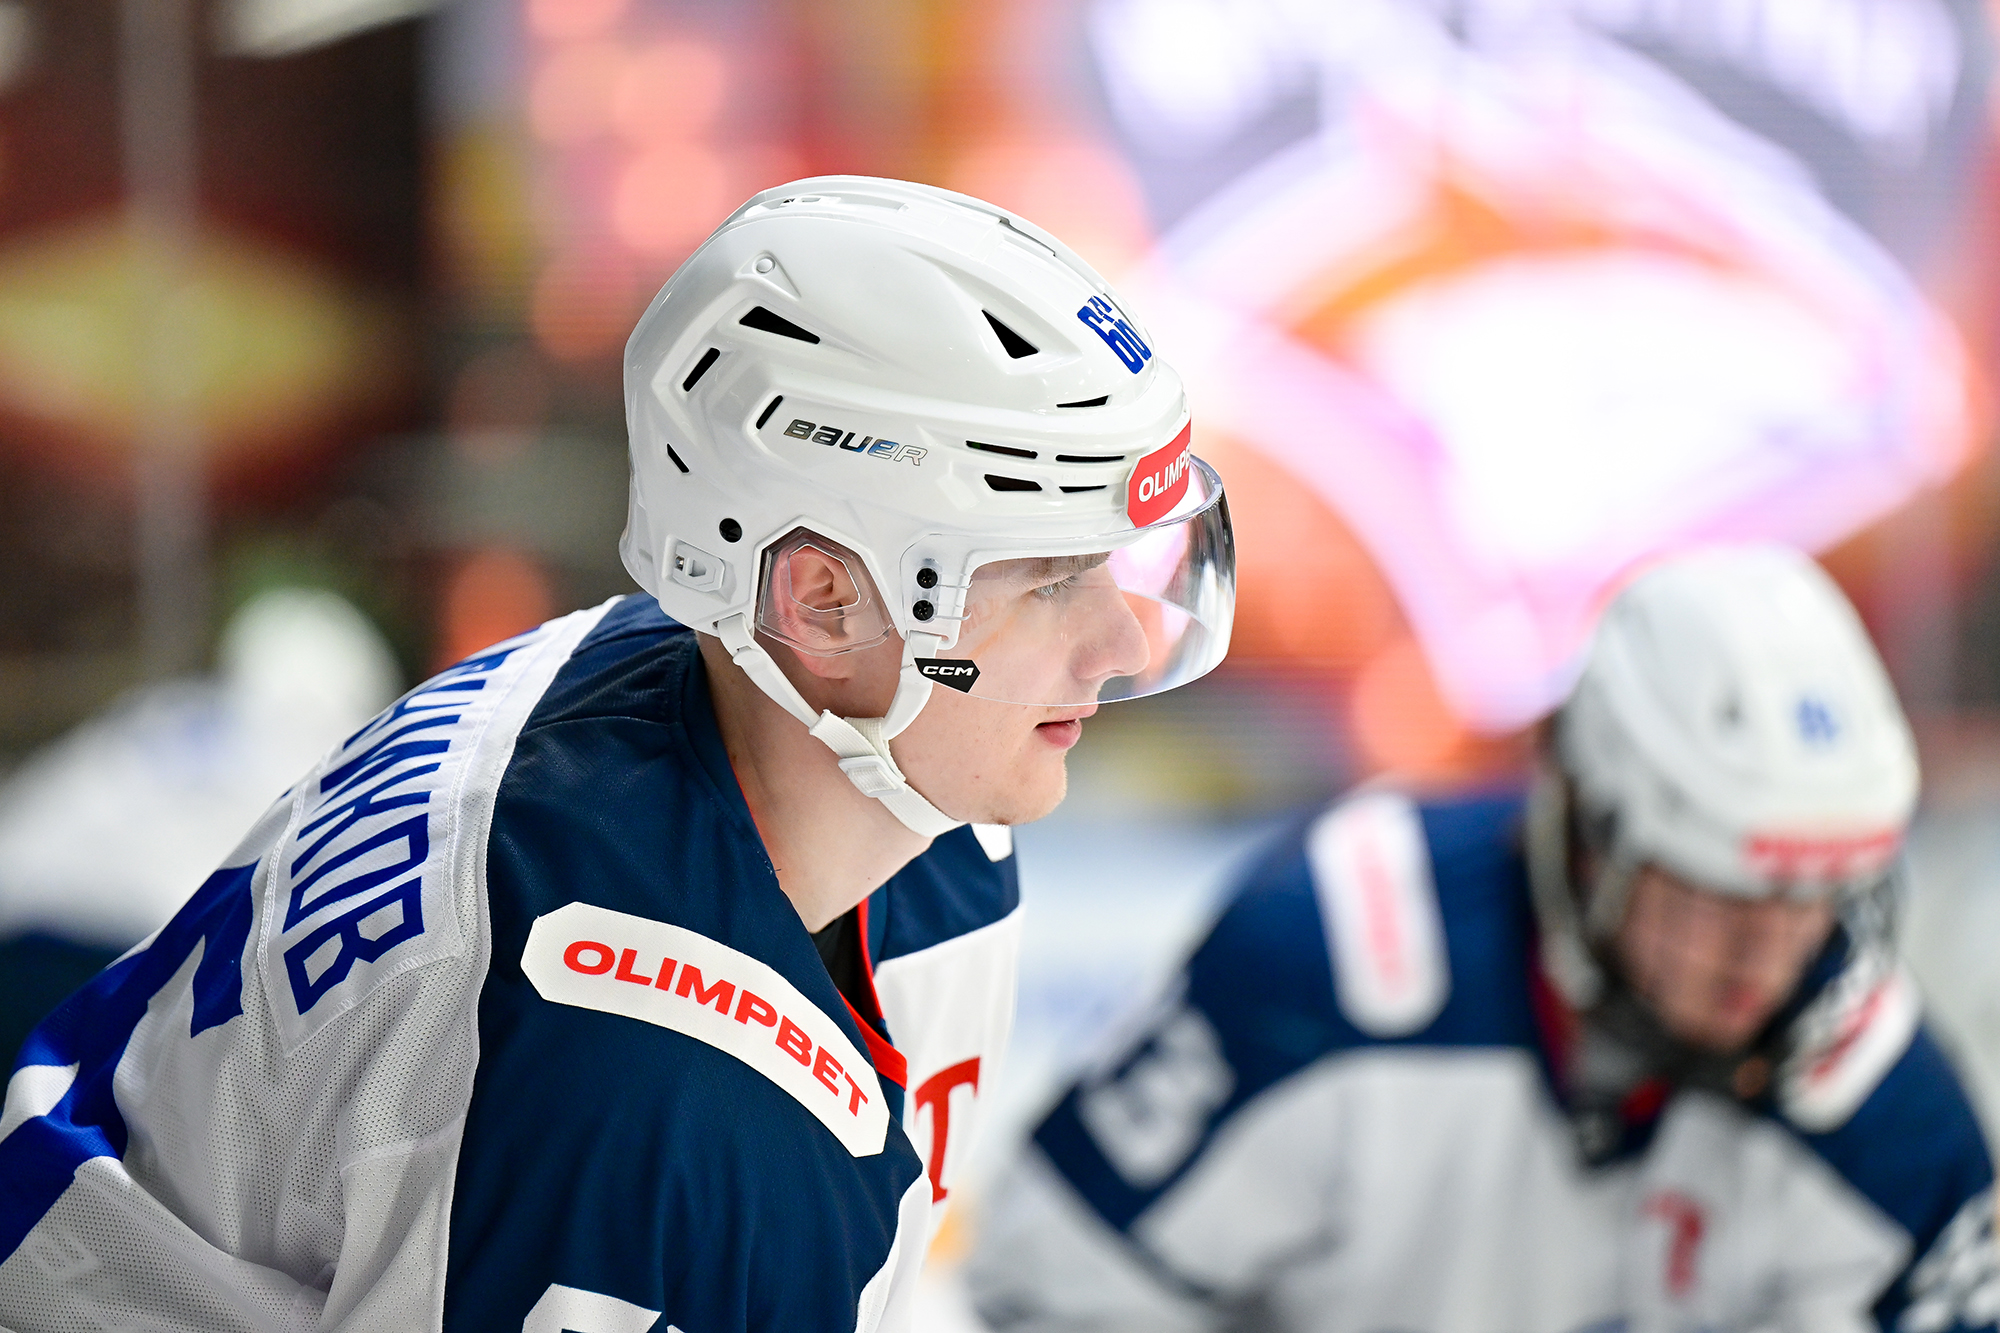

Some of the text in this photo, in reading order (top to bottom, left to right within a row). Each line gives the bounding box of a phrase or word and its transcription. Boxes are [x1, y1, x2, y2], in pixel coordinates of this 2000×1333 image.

[1077, 295, 1152, 375] 66
[783, 419, 928, 466] BAUER
[922, 666, 974, 678] CCM
[283, 625, 542, 1016] НИКОВ
[563, 940, 869, 1117] OLIMPBET
